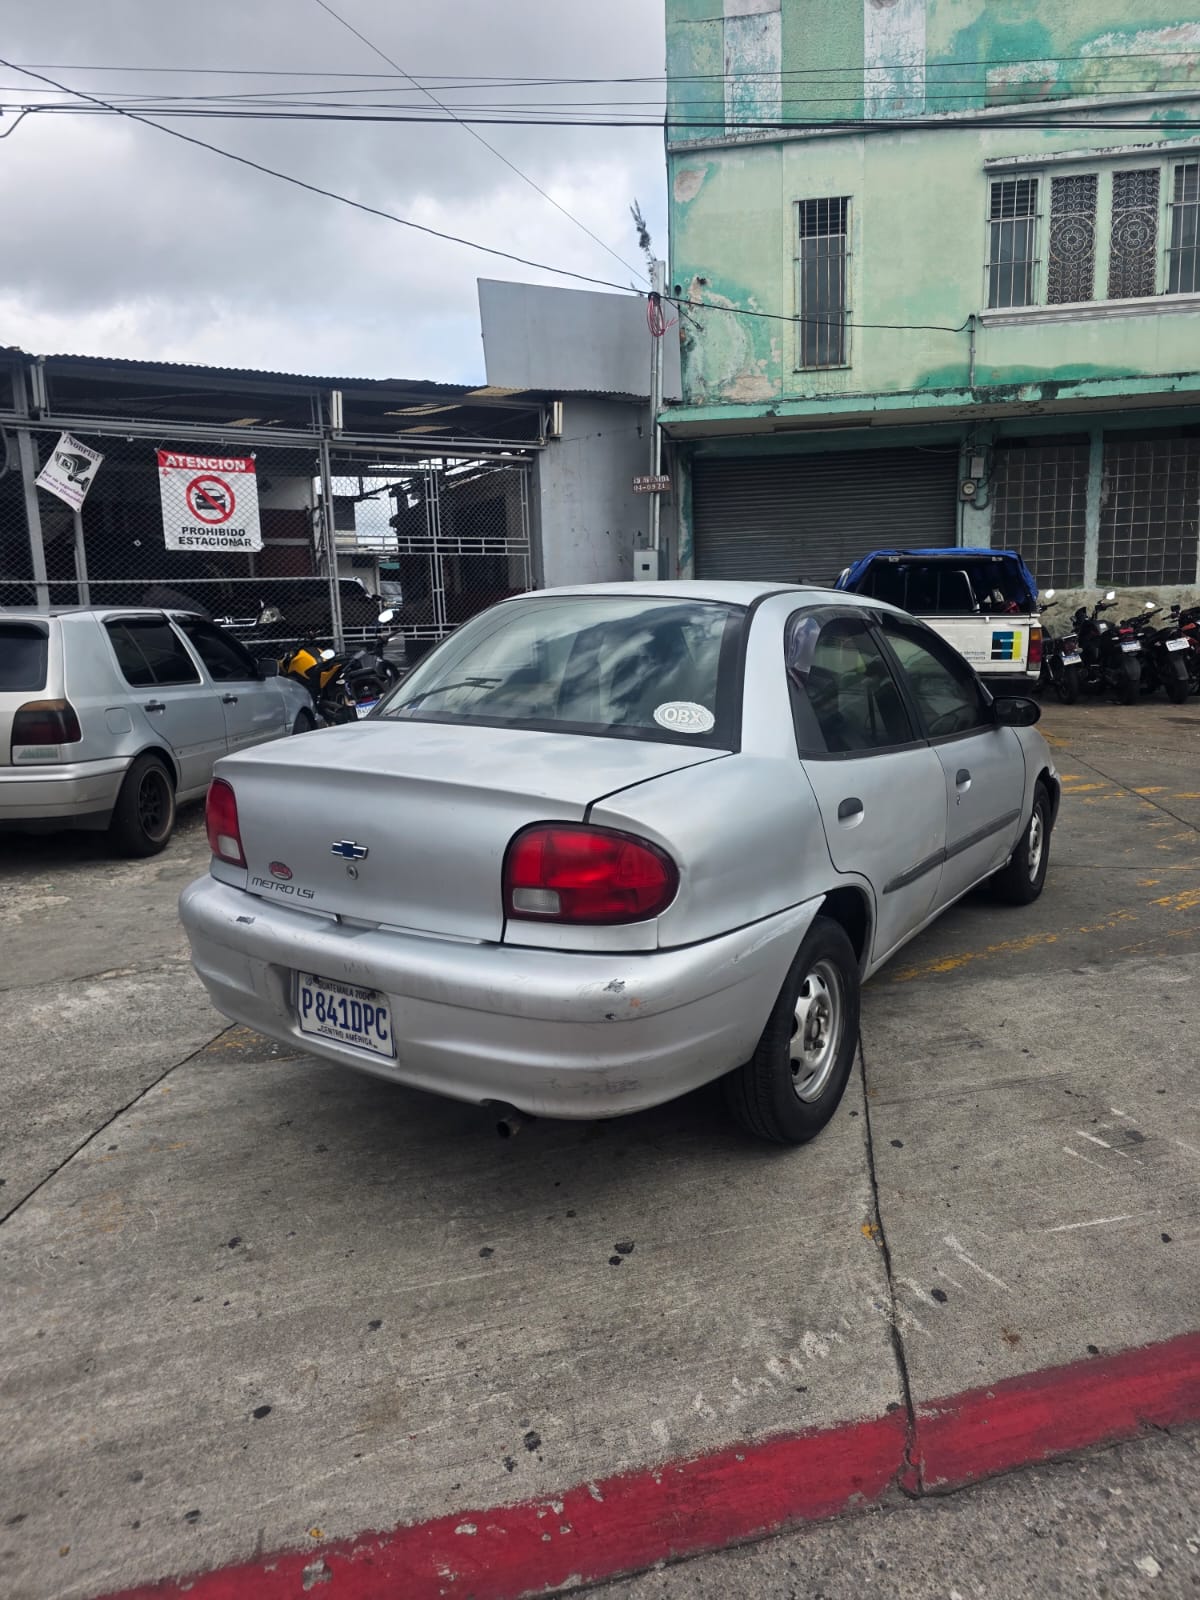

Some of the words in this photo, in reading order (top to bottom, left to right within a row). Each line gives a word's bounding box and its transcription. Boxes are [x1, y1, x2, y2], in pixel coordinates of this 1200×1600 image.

[165, 454, 246, 471] ATENCION
[181, 526, 246, 537] PROHIBIDO
[178, 536, 252, 547] ESTACIONAR
[664, 707, 704, 726] OBX
[252, 877, 295, 895] METRO
